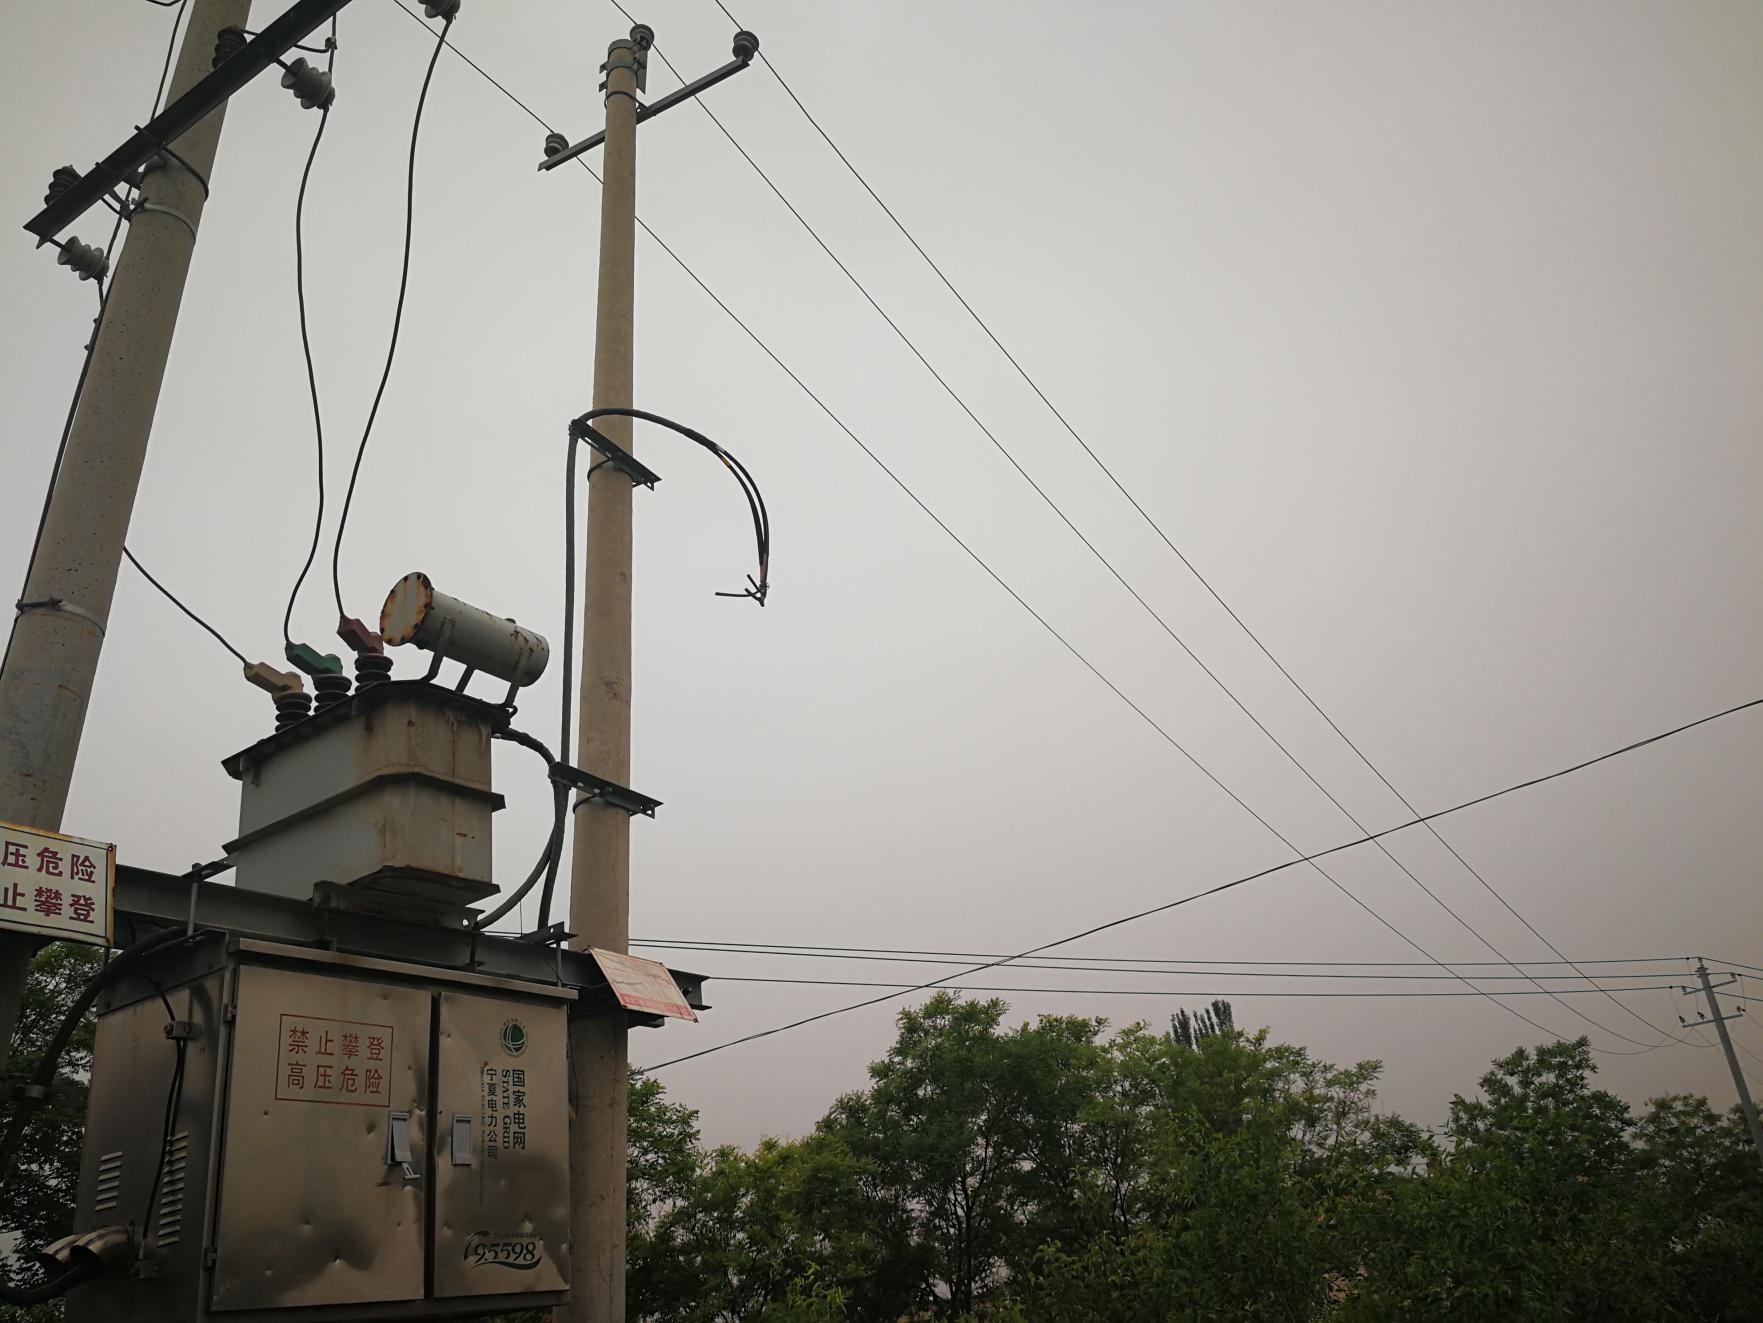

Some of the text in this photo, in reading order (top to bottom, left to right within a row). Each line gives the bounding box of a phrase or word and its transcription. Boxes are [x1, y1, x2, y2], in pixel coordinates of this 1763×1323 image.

[1, 841, 97, 884] 压危险
[0, 882, 96, 924] 止攀登
[288, 1026, 385, 1062] 禁止攀登
[286, 1061, 383, 1095] 高压危险
[486, 1068, 498, 1160] 宁夏电力公司
[501, 1069, 511, 1150] STATE GRID
[512, 1069, 526, 1150] 国家电网
[474, 1241, 537, 1264] 95598
